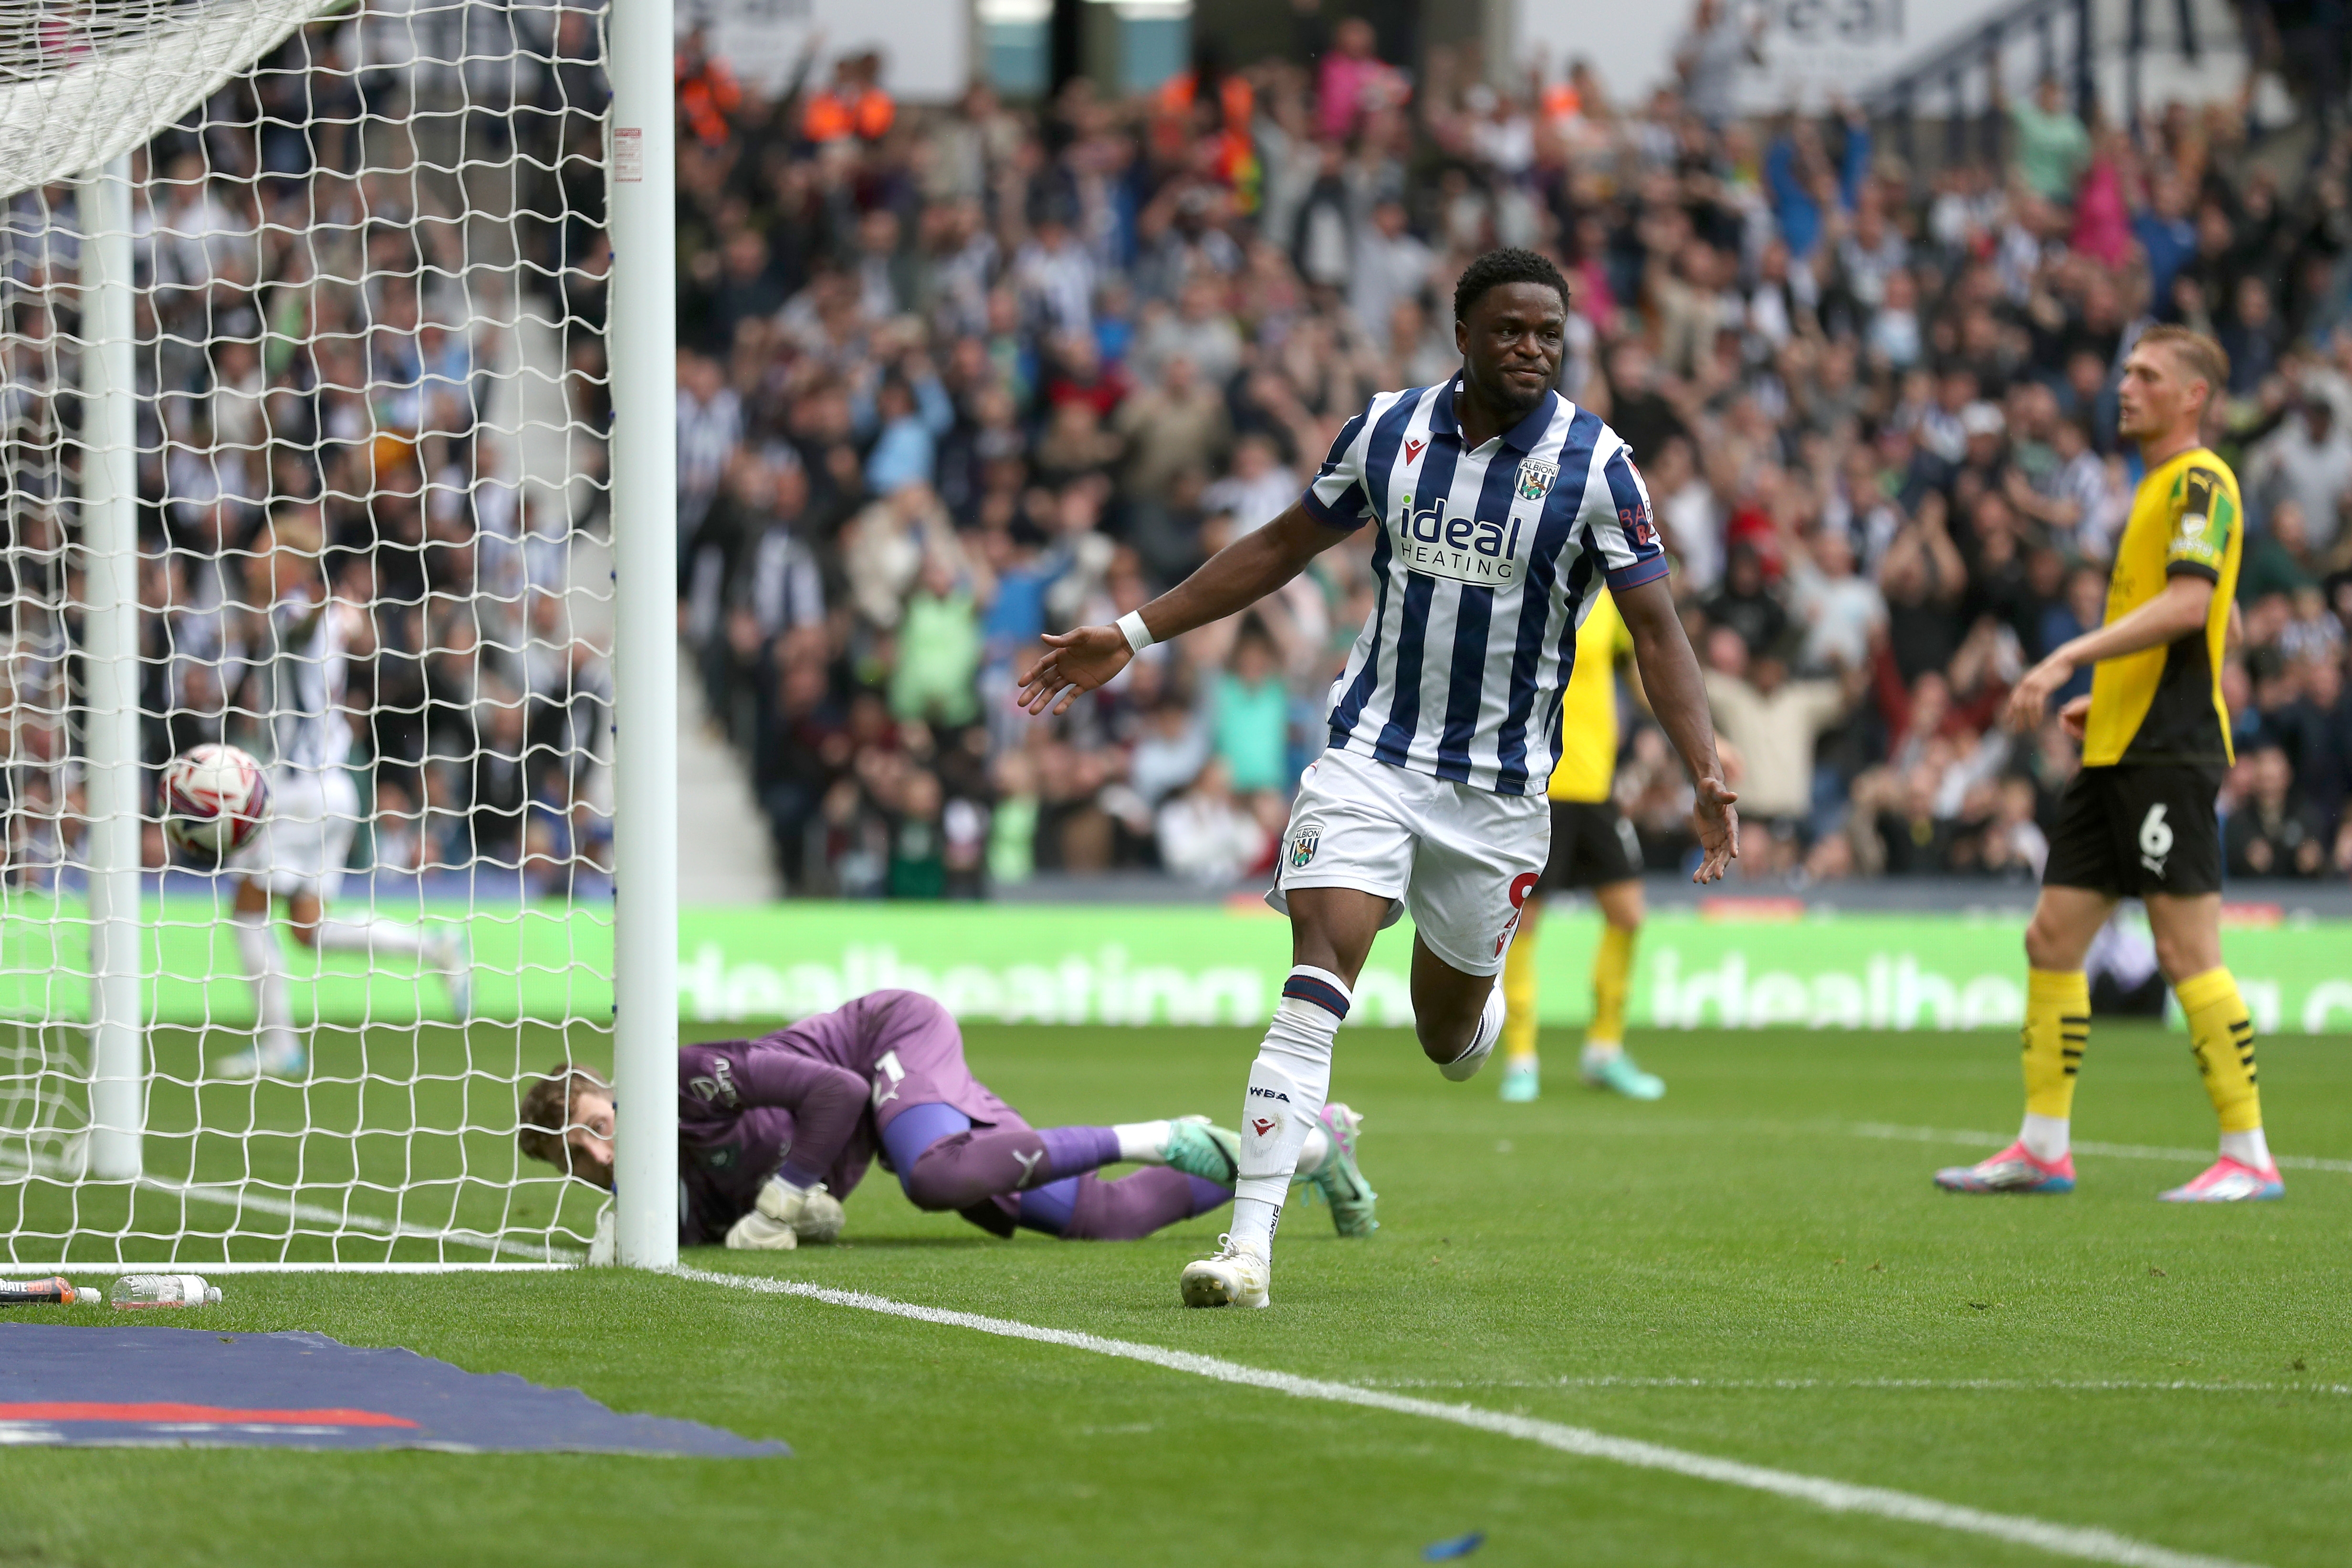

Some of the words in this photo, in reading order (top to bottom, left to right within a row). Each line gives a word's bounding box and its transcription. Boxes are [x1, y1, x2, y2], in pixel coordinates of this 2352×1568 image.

[1521, 462, 1556, 475] ALBION
[1401, 495, 1521, 560] ideal
[1401, 542, 1512, 578] HEATING
[1295, 830, 1320, 839] ALBION
[2138, 803, 2174, 857] 6
[678, 939, 1265, 1024] dealheating
[874, 1050, 906, 1083] 1
[1250, 1087, 1290, 1103] WBA
